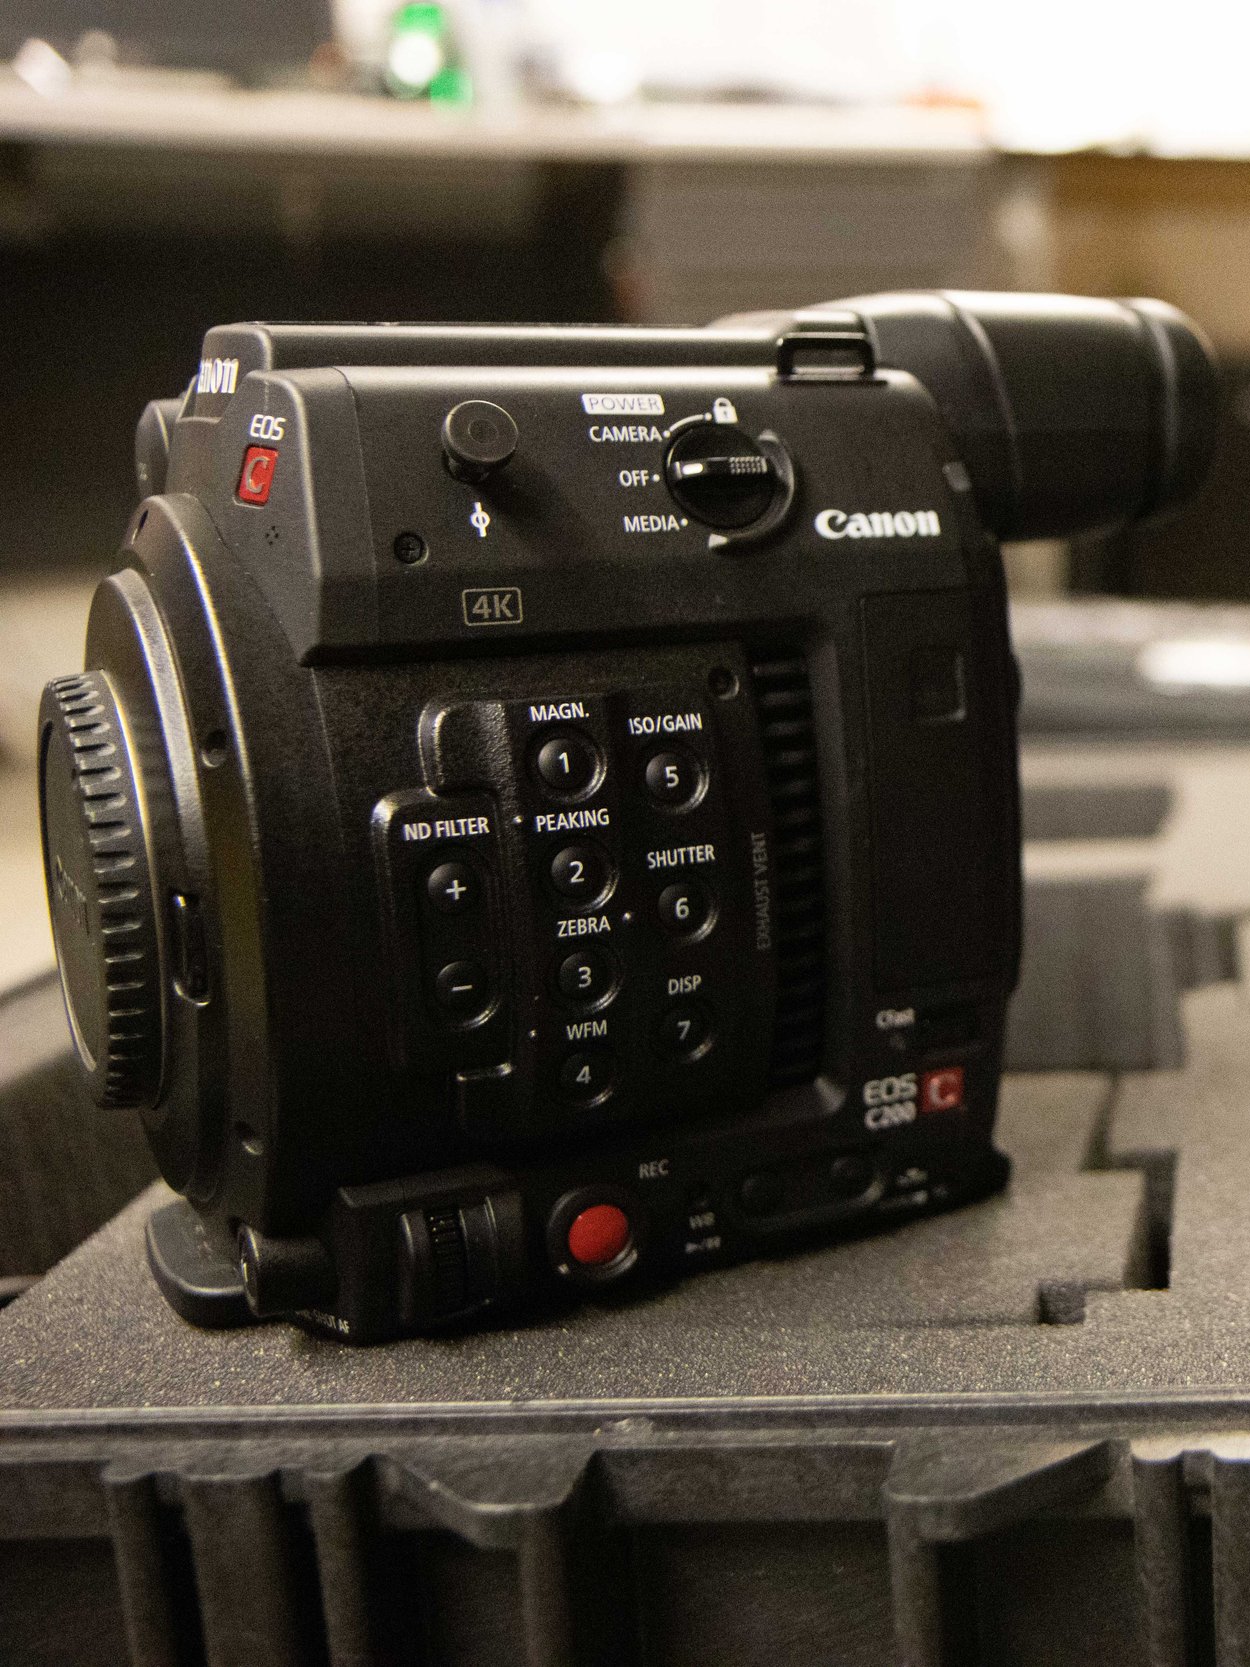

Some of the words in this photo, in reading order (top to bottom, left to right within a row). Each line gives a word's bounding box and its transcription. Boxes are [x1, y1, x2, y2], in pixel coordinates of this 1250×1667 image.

[588, 396, 662, 412] POWER
[250, 414, 287, 440] EOS
[589, 425, 663, 443] CAMERA
[246, 455, 271, 494] C
[619, 470, 650, 487] OFF
[623, 514, 681, 533] MEDIA
[814, 509, 941, 539] Canon
[472, 594, 514, 619] 4K
[530, 702, 590, 722] MAGN.
[628, 713, 703, 735] ISO/GAIN
[558, 752, 570, 774] 1
[665, 766, 680, 788] 5
[404, 822, 432, 842] ND
[436, 817, 490, 838] FILTER
[536, 808, 611, 833] PEAKING
[647, 844, 716, 870] SHUTTER
[570, 861, 585, 884] 2
[675, 896, 690, 919] 6
[557, 915, 612, 938] ZEBRA
[577, 966, 592, 988] 3
[668, 974, 703, 996] DISP
[566, 1020, 608, 1041] WFM
[677, 1020, 691, 1041] 7
[575, 1065, 591, 1085] 4
[863, 1073, 918, 1106] EOS
[639, 1158, 669, 1180] REC
